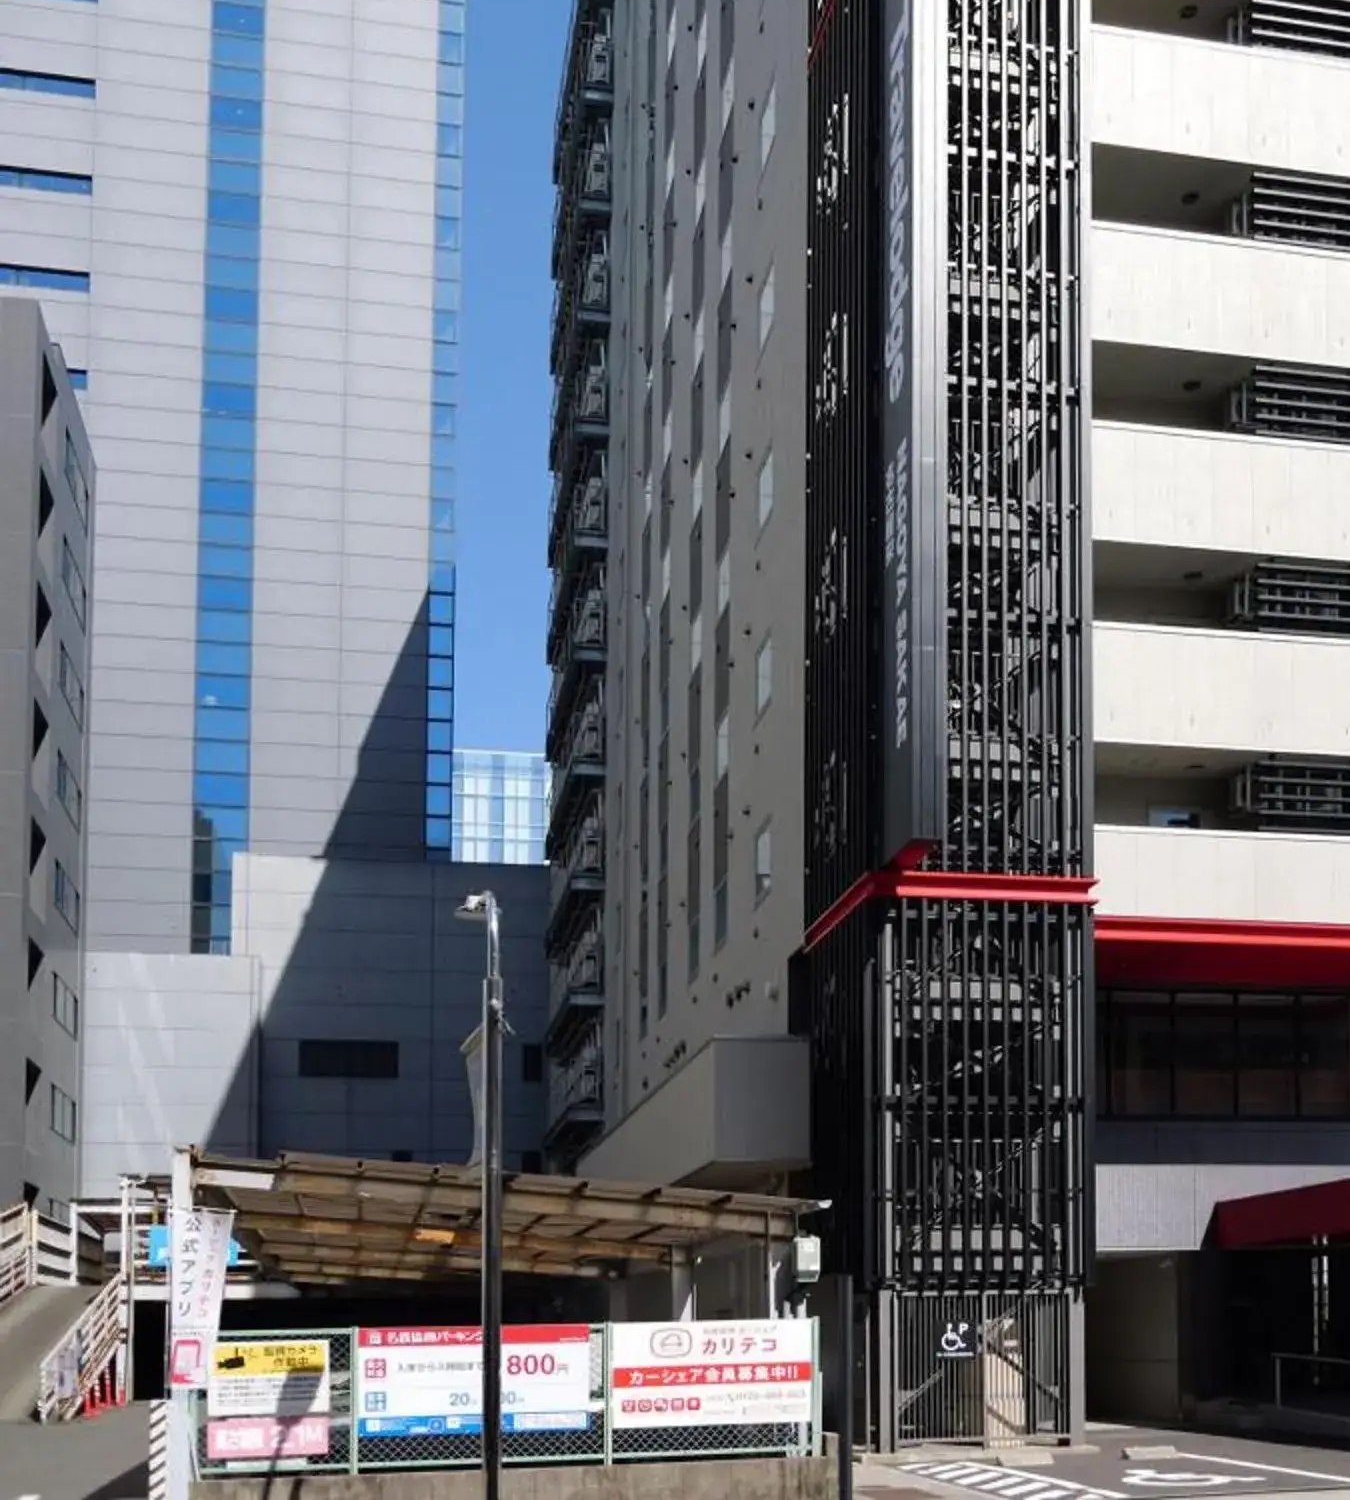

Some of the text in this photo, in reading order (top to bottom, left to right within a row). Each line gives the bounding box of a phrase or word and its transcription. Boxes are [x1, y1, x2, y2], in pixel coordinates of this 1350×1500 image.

[896, 436, 908, 608] NAGOYA
[178, 1217, 202, 1317] 公式アプリ
[702, 1337, 777, 1355] カリテコ
[959, 1322, 969, 1335] P
